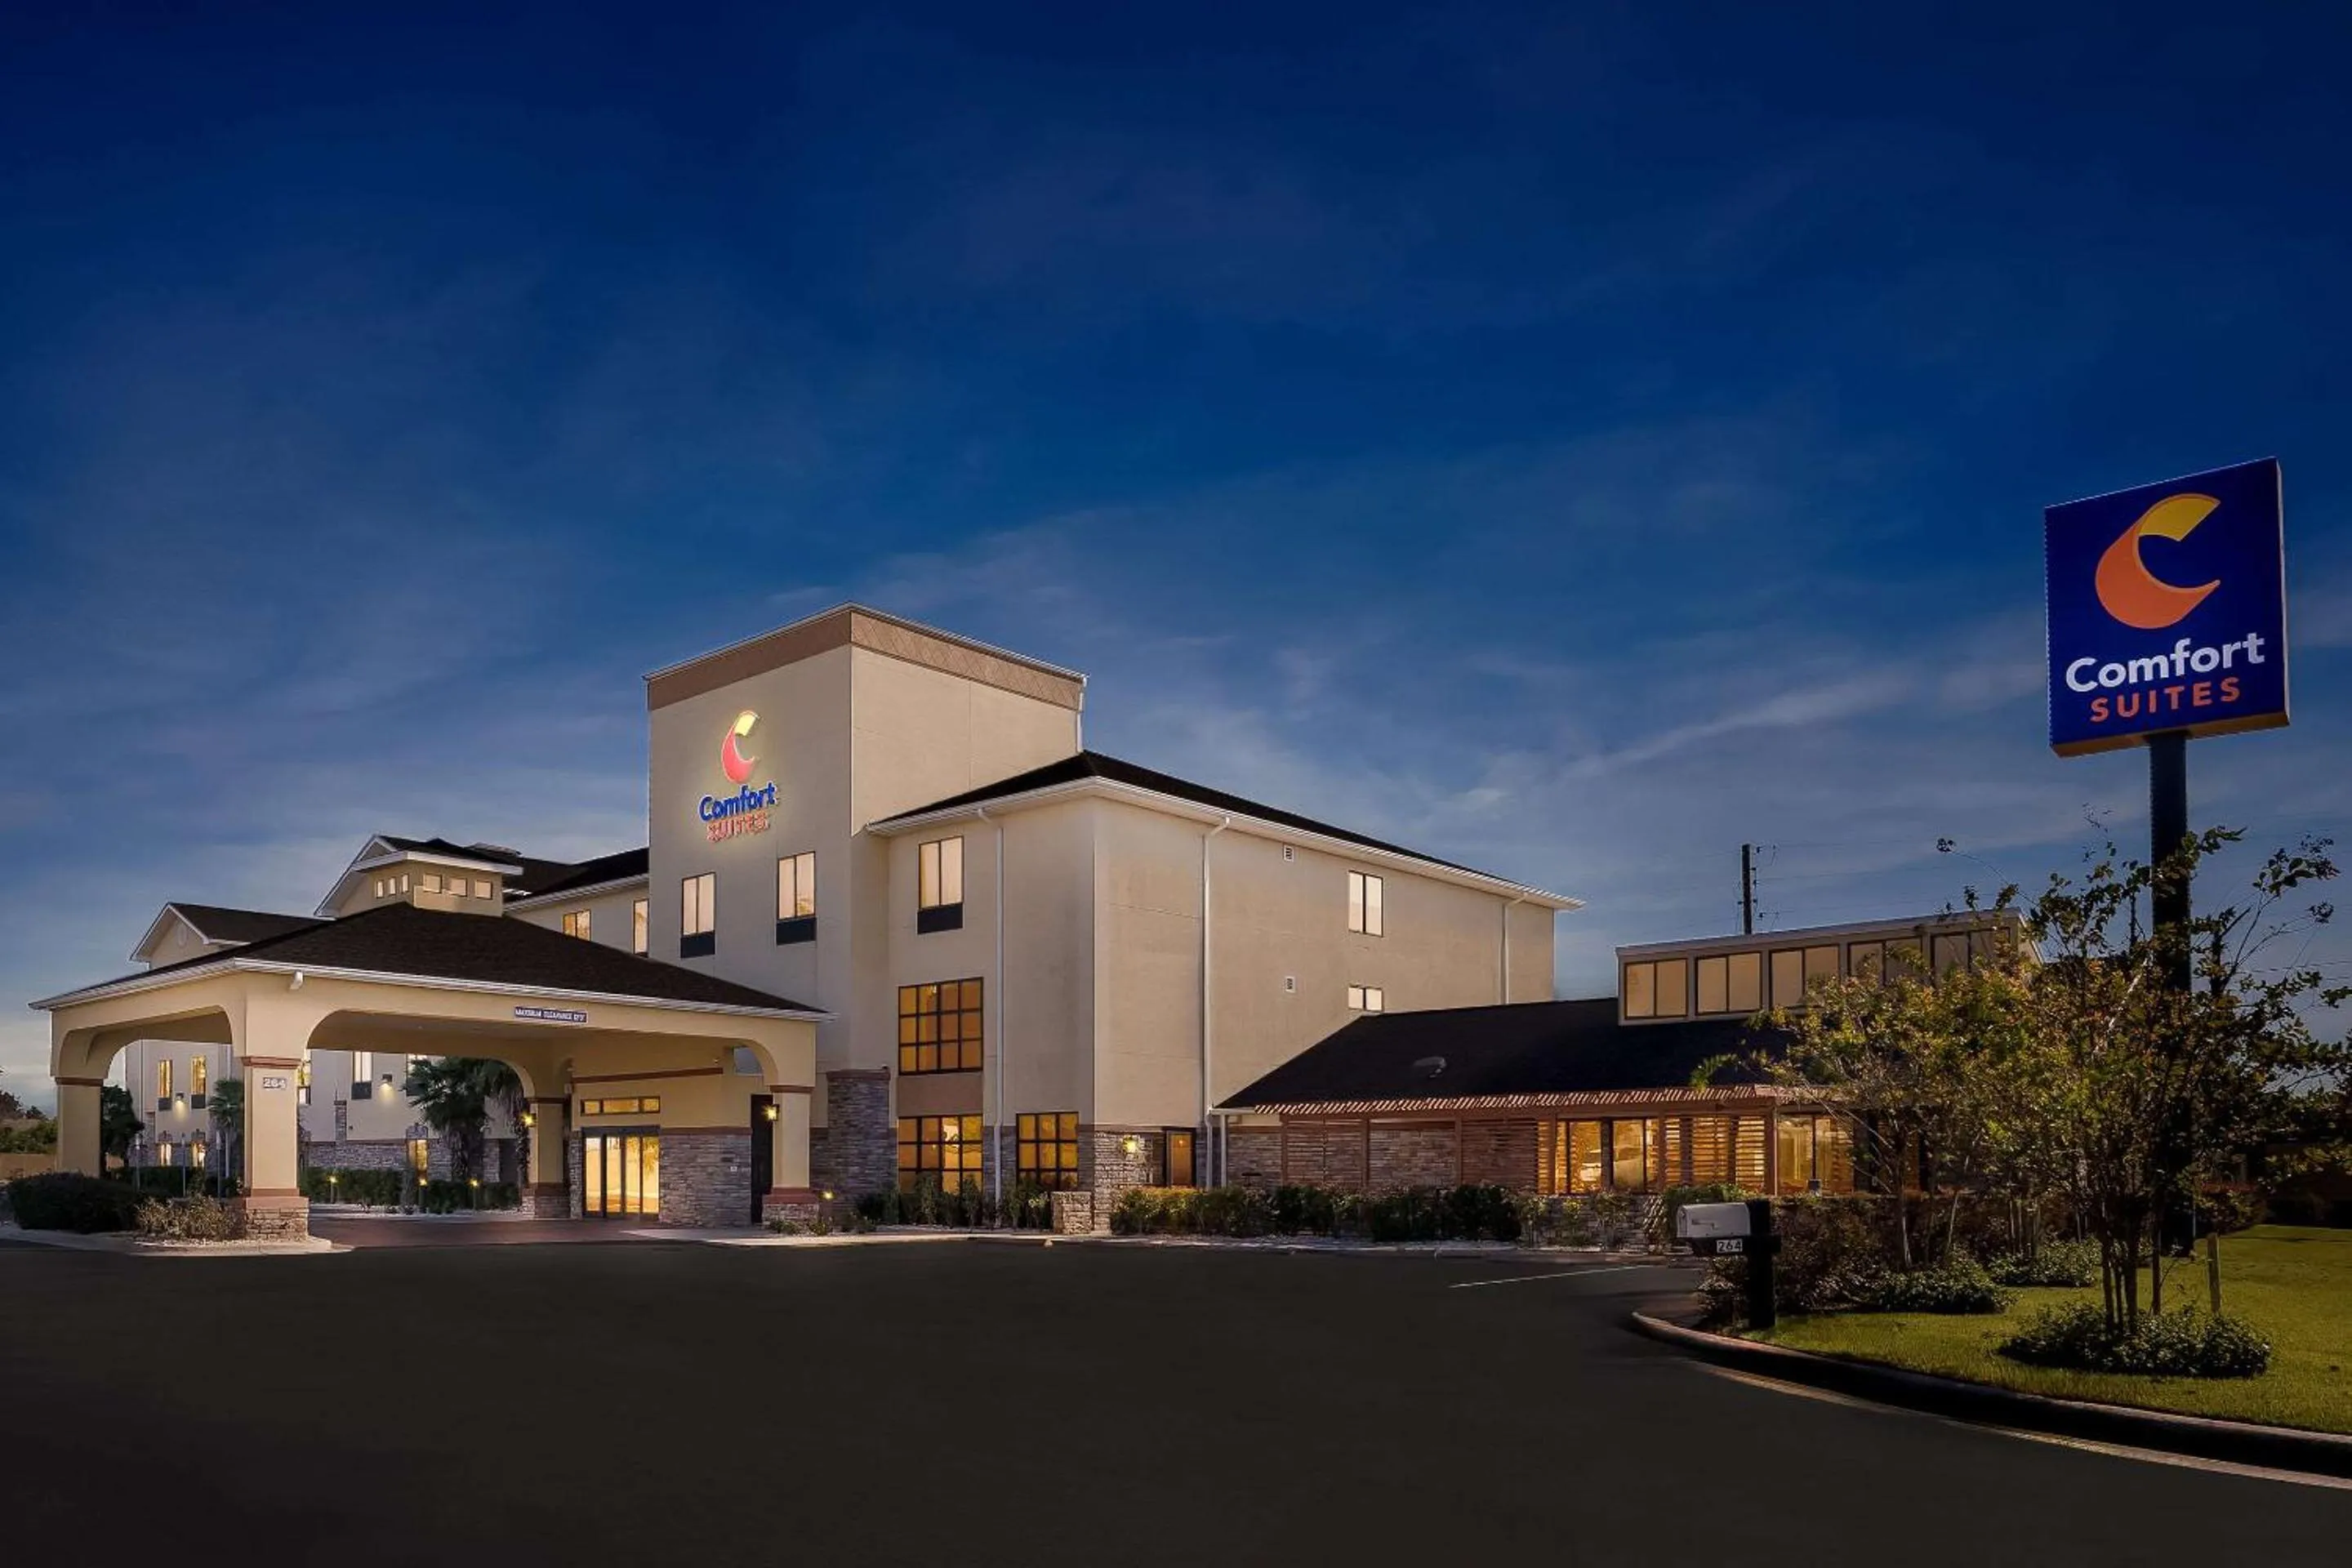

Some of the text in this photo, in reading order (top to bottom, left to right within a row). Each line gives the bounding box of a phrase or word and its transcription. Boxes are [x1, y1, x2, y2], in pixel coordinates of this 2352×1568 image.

[2065, 632, 2265, 693] Comfort
[2090, 676, 2240, 723] SUITES
[699, 780, 777, 822] Comfort
[706, 809, 770, 843] SUITES
[1718, 1241, 1742, 1252] 264
